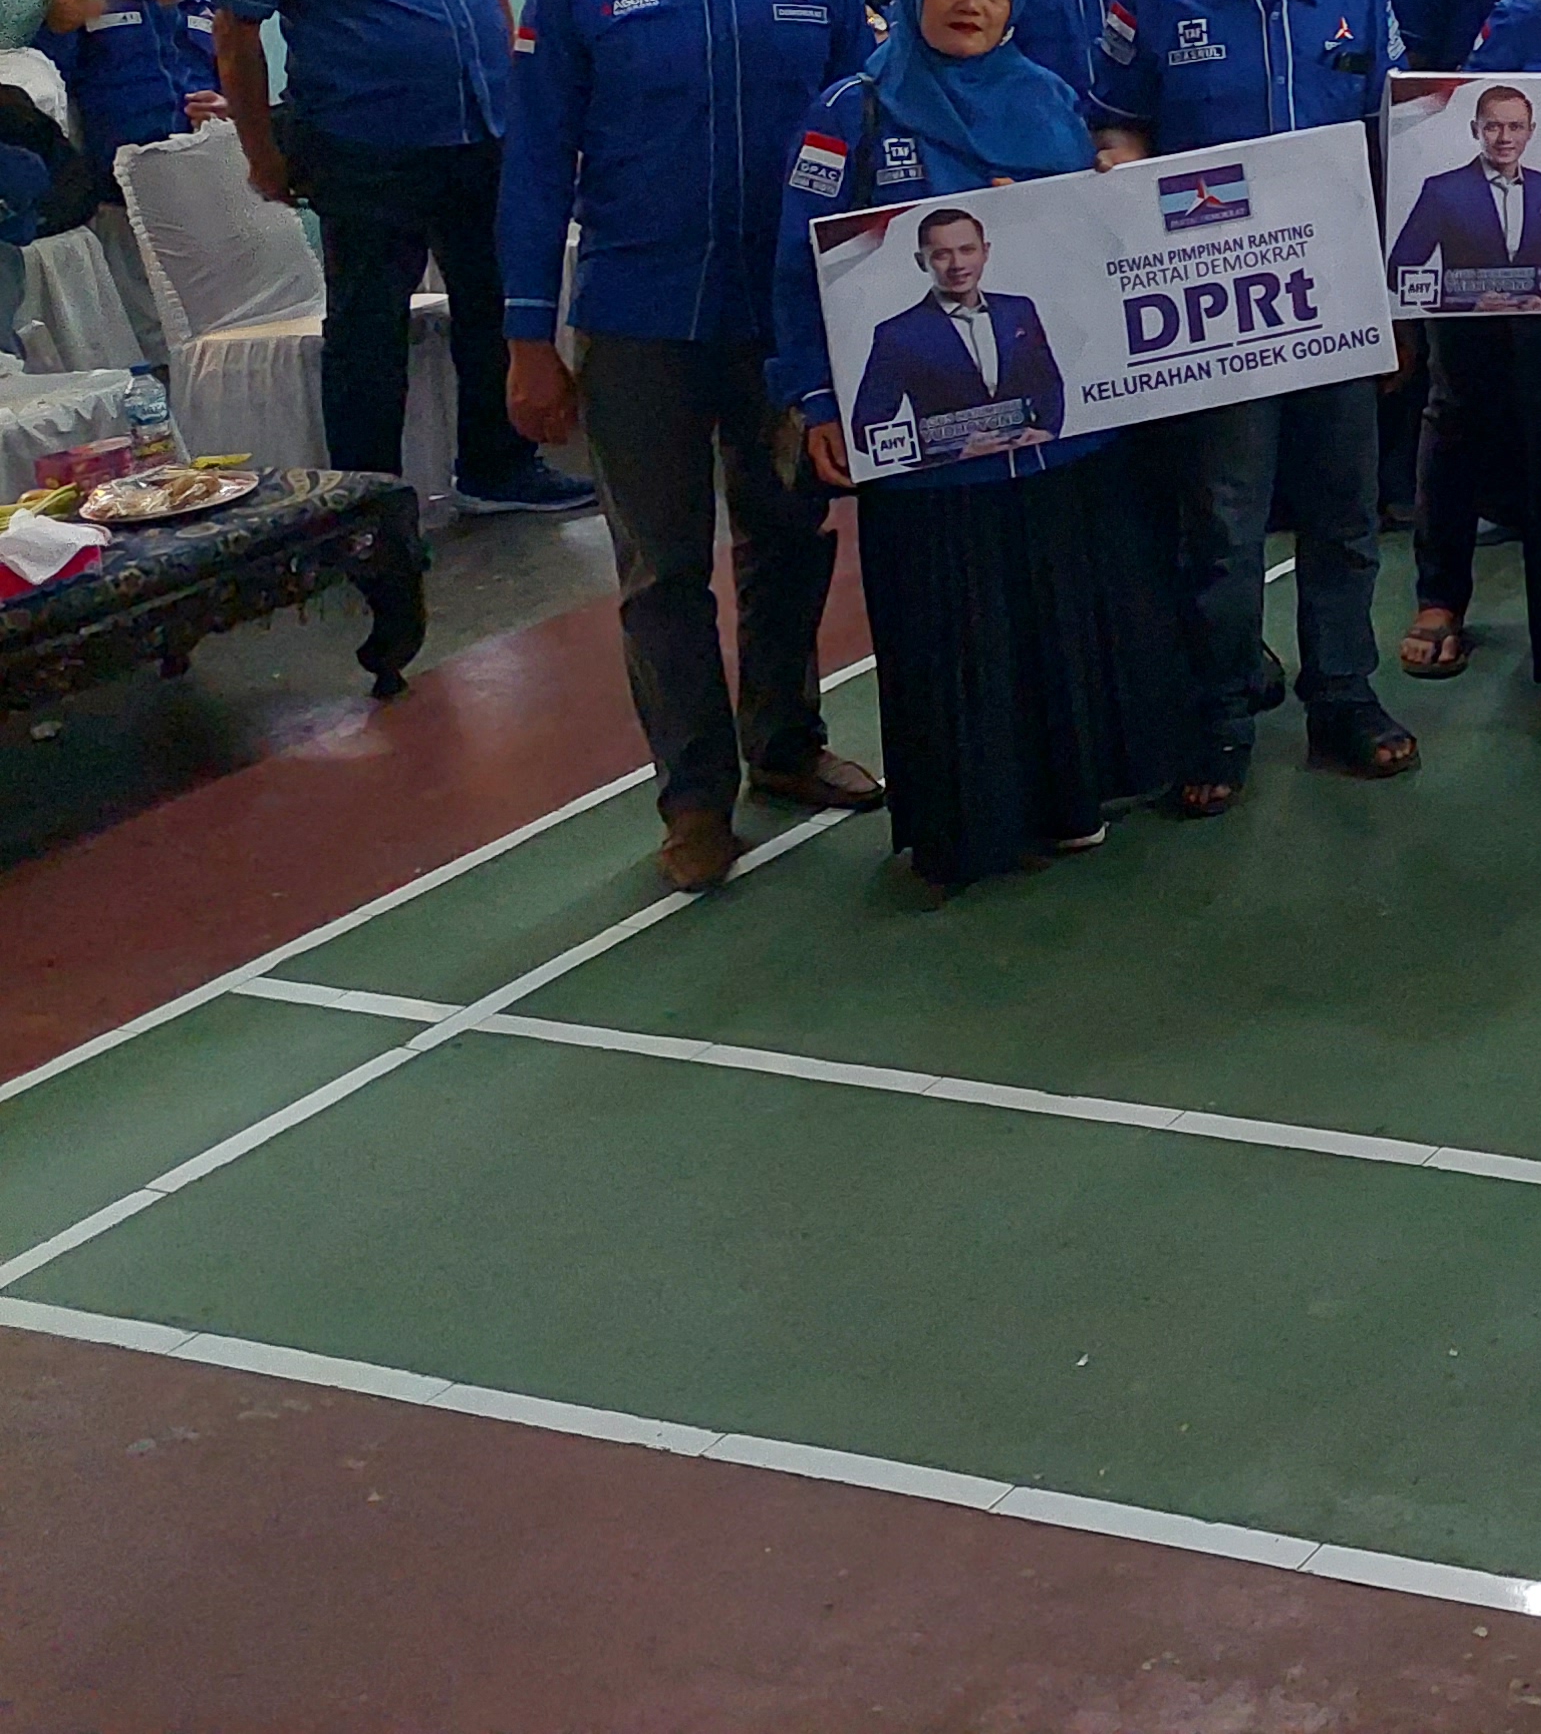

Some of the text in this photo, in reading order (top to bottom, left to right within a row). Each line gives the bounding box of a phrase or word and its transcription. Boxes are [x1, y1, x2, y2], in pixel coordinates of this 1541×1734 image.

[800, 162, 838, 180] DPAC
[1106, 223, 1314, 276] DEWAN PIMPINAN RANTING
[1120, 241, 1309, 292] PARTAI DEMOKRAT
[1123, 267, 1318, 356] DPRt
[1081, 327, 1381, 404] KELURAHAN TOBEK GODANG
[879, 435, 906, 452] AHY
